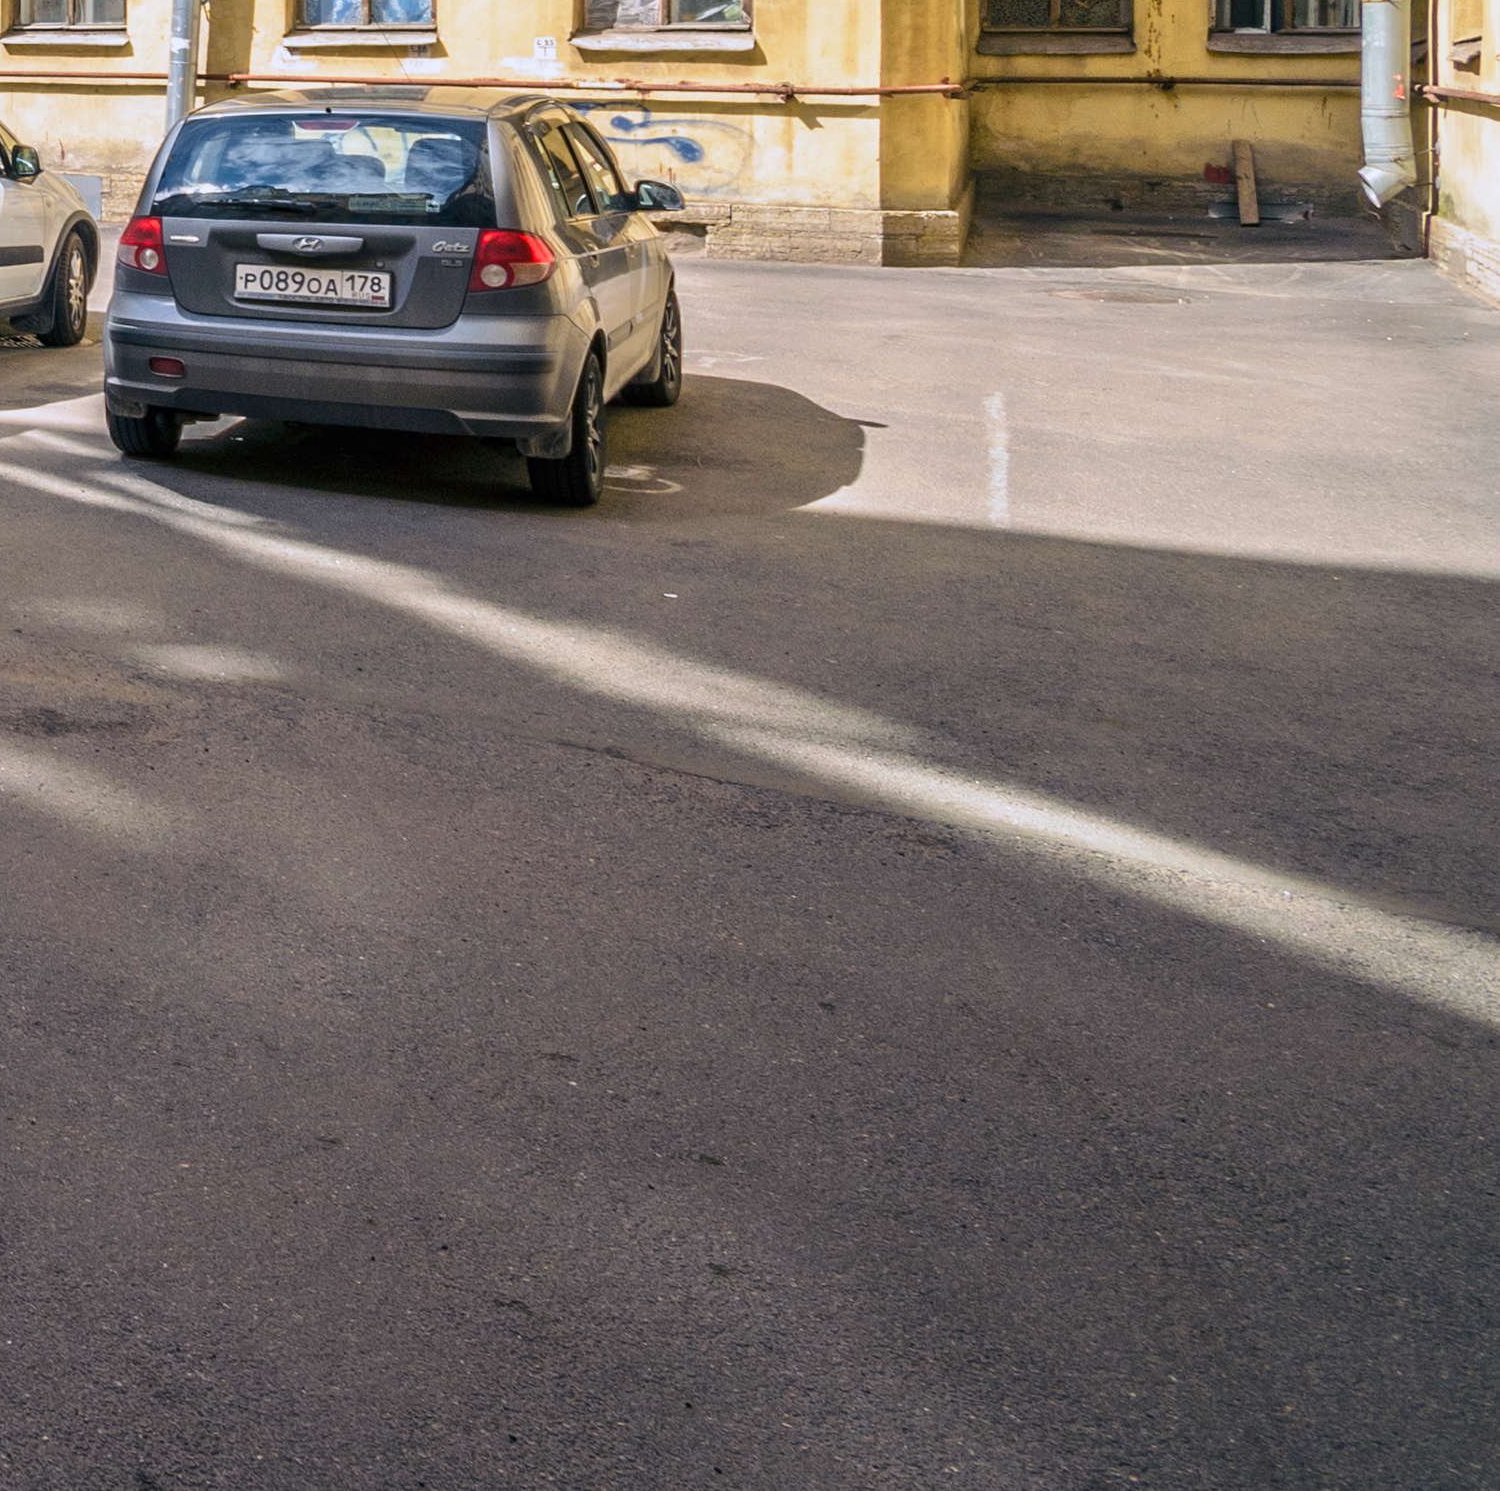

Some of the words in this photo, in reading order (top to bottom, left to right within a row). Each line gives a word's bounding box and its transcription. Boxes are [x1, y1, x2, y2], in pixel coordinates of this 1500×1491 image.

[431, 240, 471, 253] Getz
[243, 269, 338, 296] Р089ОА
[344, 274, 382, 293] 178
